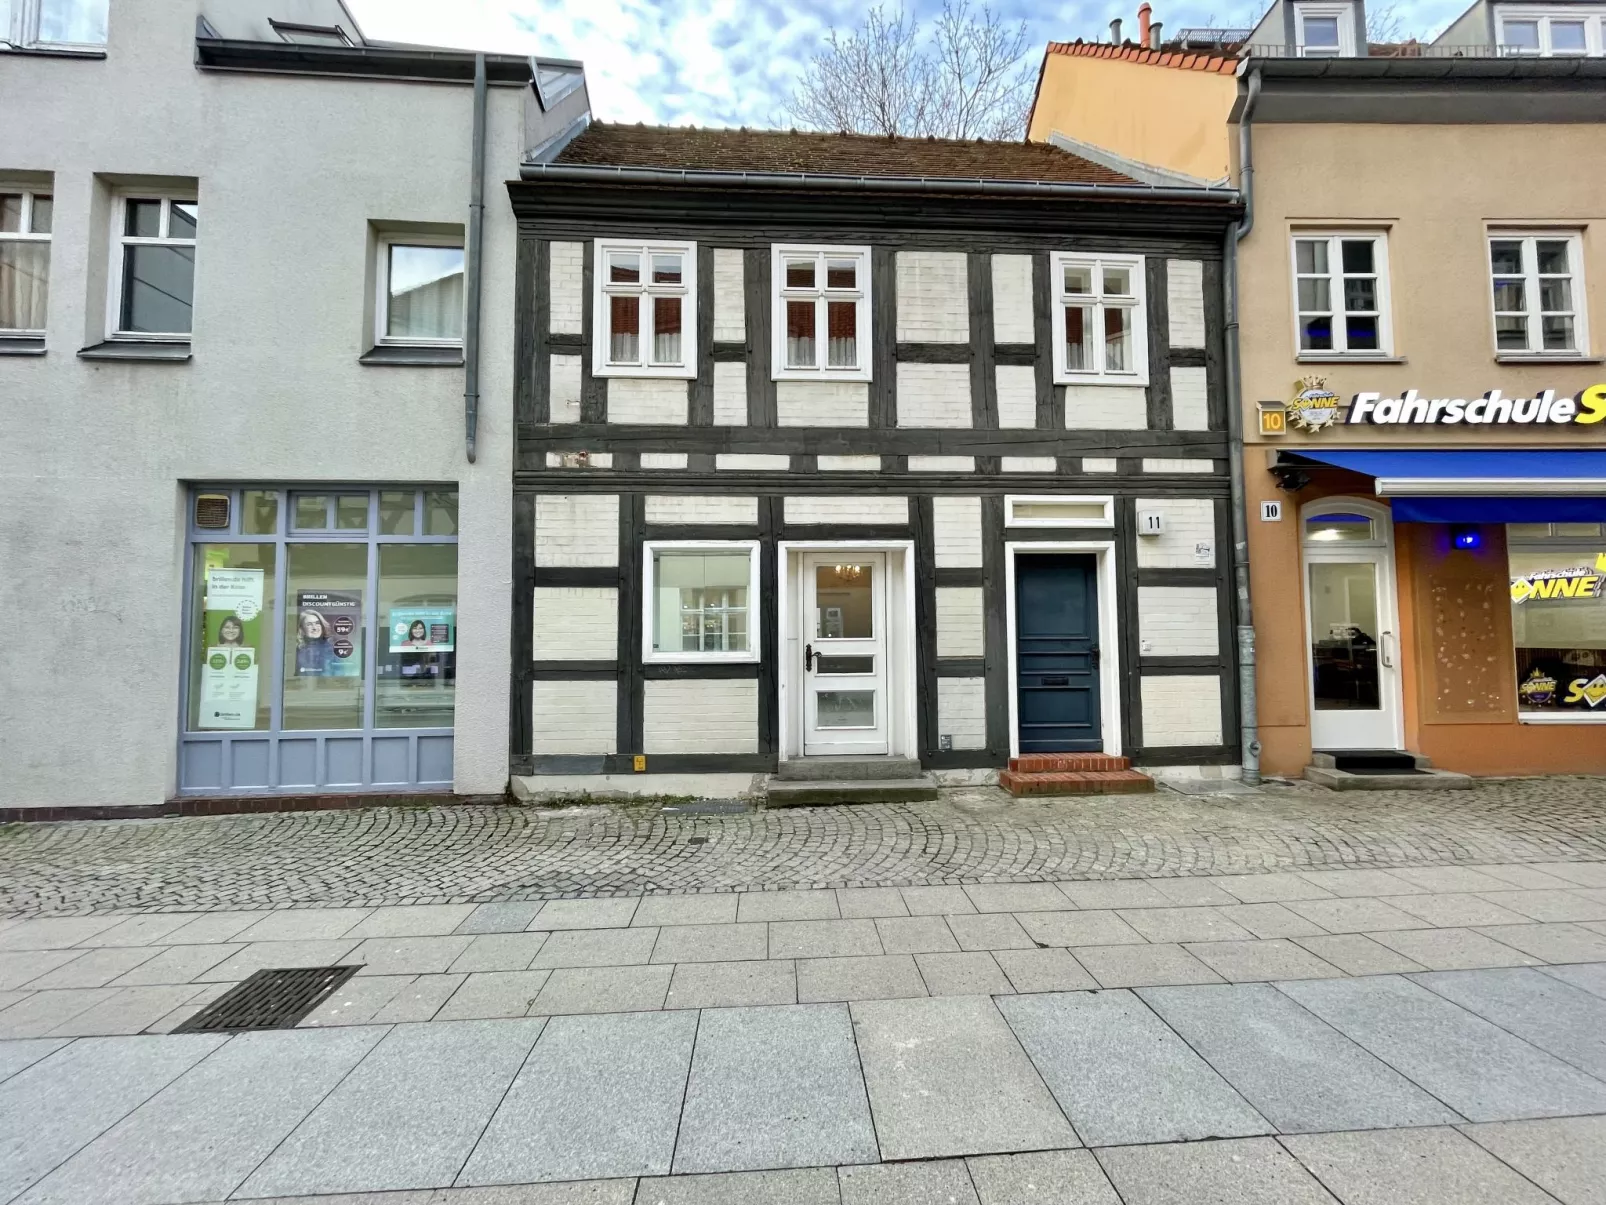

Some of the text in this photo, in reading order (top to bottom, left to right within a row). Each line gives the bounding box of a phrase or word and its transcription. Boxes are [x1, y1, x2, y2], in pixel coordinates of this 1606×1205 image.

[1350, 389, 1575, 424] Fahrschule
[1263, 413, 1282, 430] 10
[1265, 504, 1278, 518] 10
[1148, 516, 1160, 529] 11
